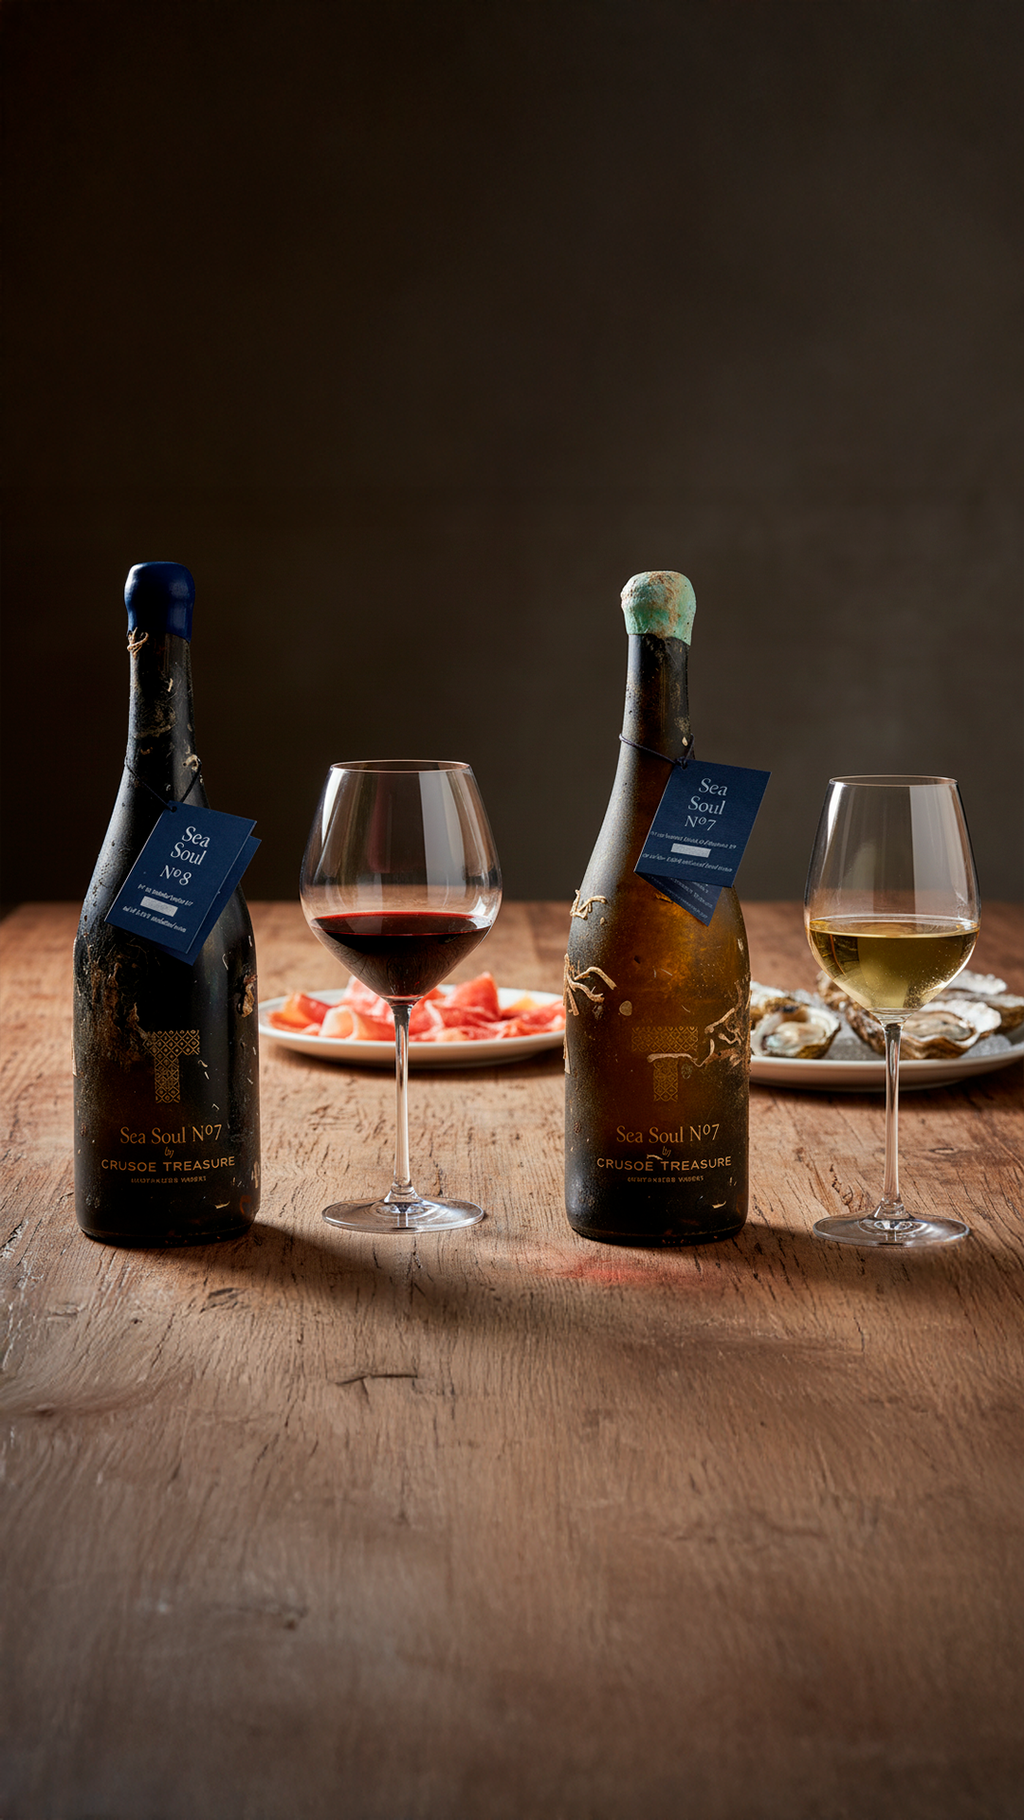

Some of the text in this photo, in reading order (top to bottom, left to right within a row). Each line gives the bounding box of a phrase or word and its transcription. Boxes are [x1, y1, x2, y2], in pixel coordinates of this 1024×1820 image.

[698, 777, 728, 797] Sea
[688, 795, 726, 815] Soul
[181, 825, 211, 849] Sea
[170, 842, 207, 866] Soul
[120, 1126, 146, 1144] Sea
[151, 1126, 186, 1145] Soul
[616, 1125, 643, 1143] Sea
[648, 1126, 684, 1144] Soul
[101, 1156, 235, 1172] CRUSOE TREASURE
[596, 1156, 732, 1172] CRUSOE TREASURE
